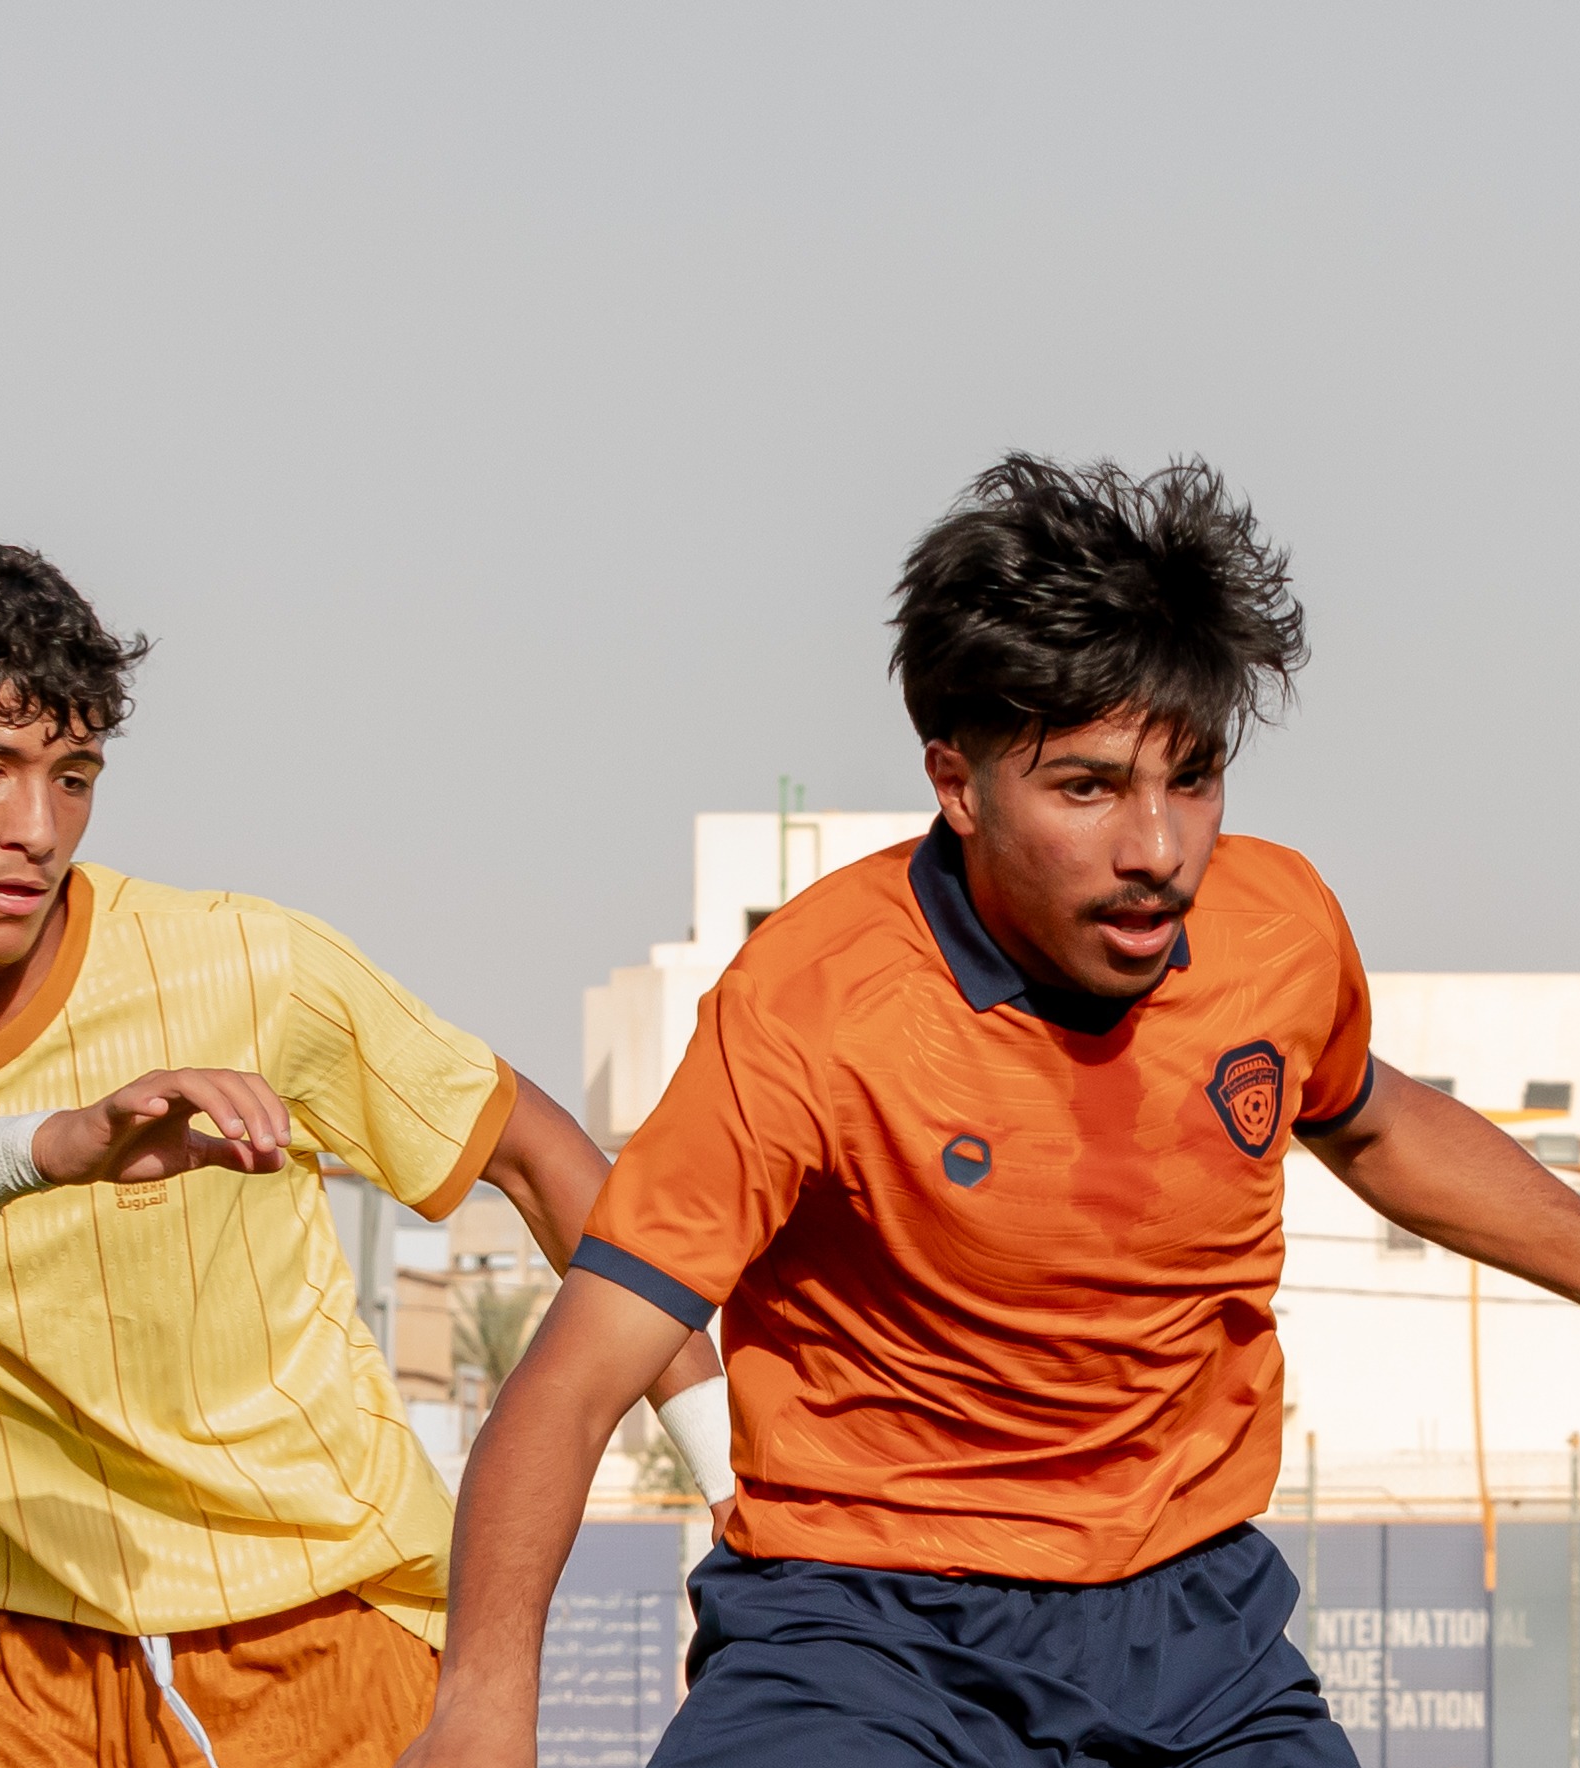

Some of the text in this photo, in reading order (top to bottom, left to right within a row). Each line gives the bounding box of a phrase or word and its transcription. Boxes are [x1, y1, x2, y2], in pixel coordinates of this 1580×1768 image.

[116, 1192, 169, 1211] العروبة
[1315, 1609, 1534, 1648] NTERNATIONAL
[1322, 1690, 1486, 1730] EDERATION
